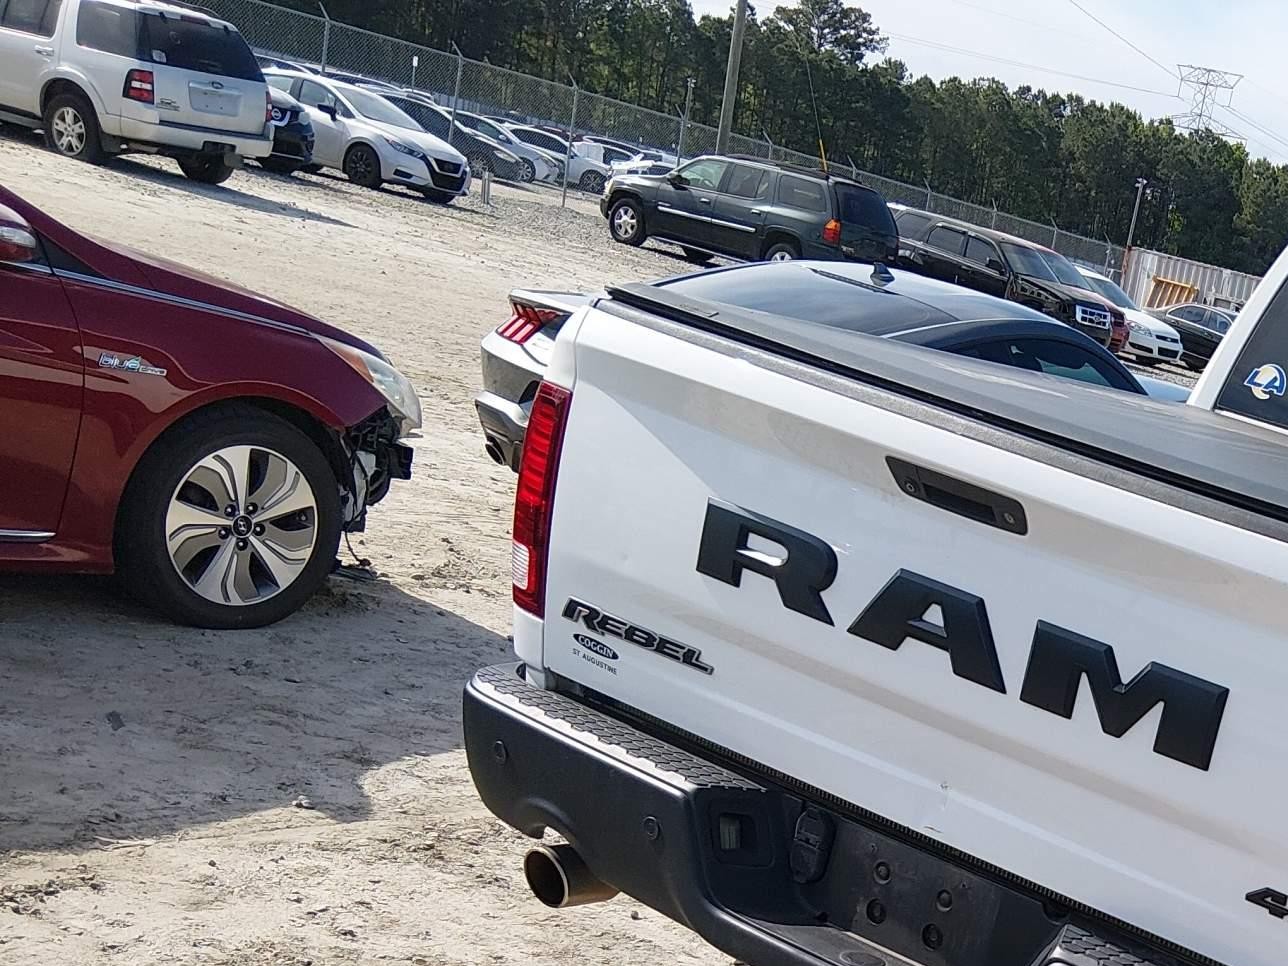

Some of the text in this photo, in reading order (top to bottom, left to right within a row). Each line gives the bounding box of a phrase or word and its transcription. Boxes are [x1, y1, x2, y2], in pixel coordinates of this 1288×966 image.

[98, 352, 141, 371] blue
[561, 595, 715, 676] REBEL
[577, 634, 615, 659] COGGIN
[696, 497, 1230, 772] RAM
[572, 648, 618, 676] ST AUGUSTINE
